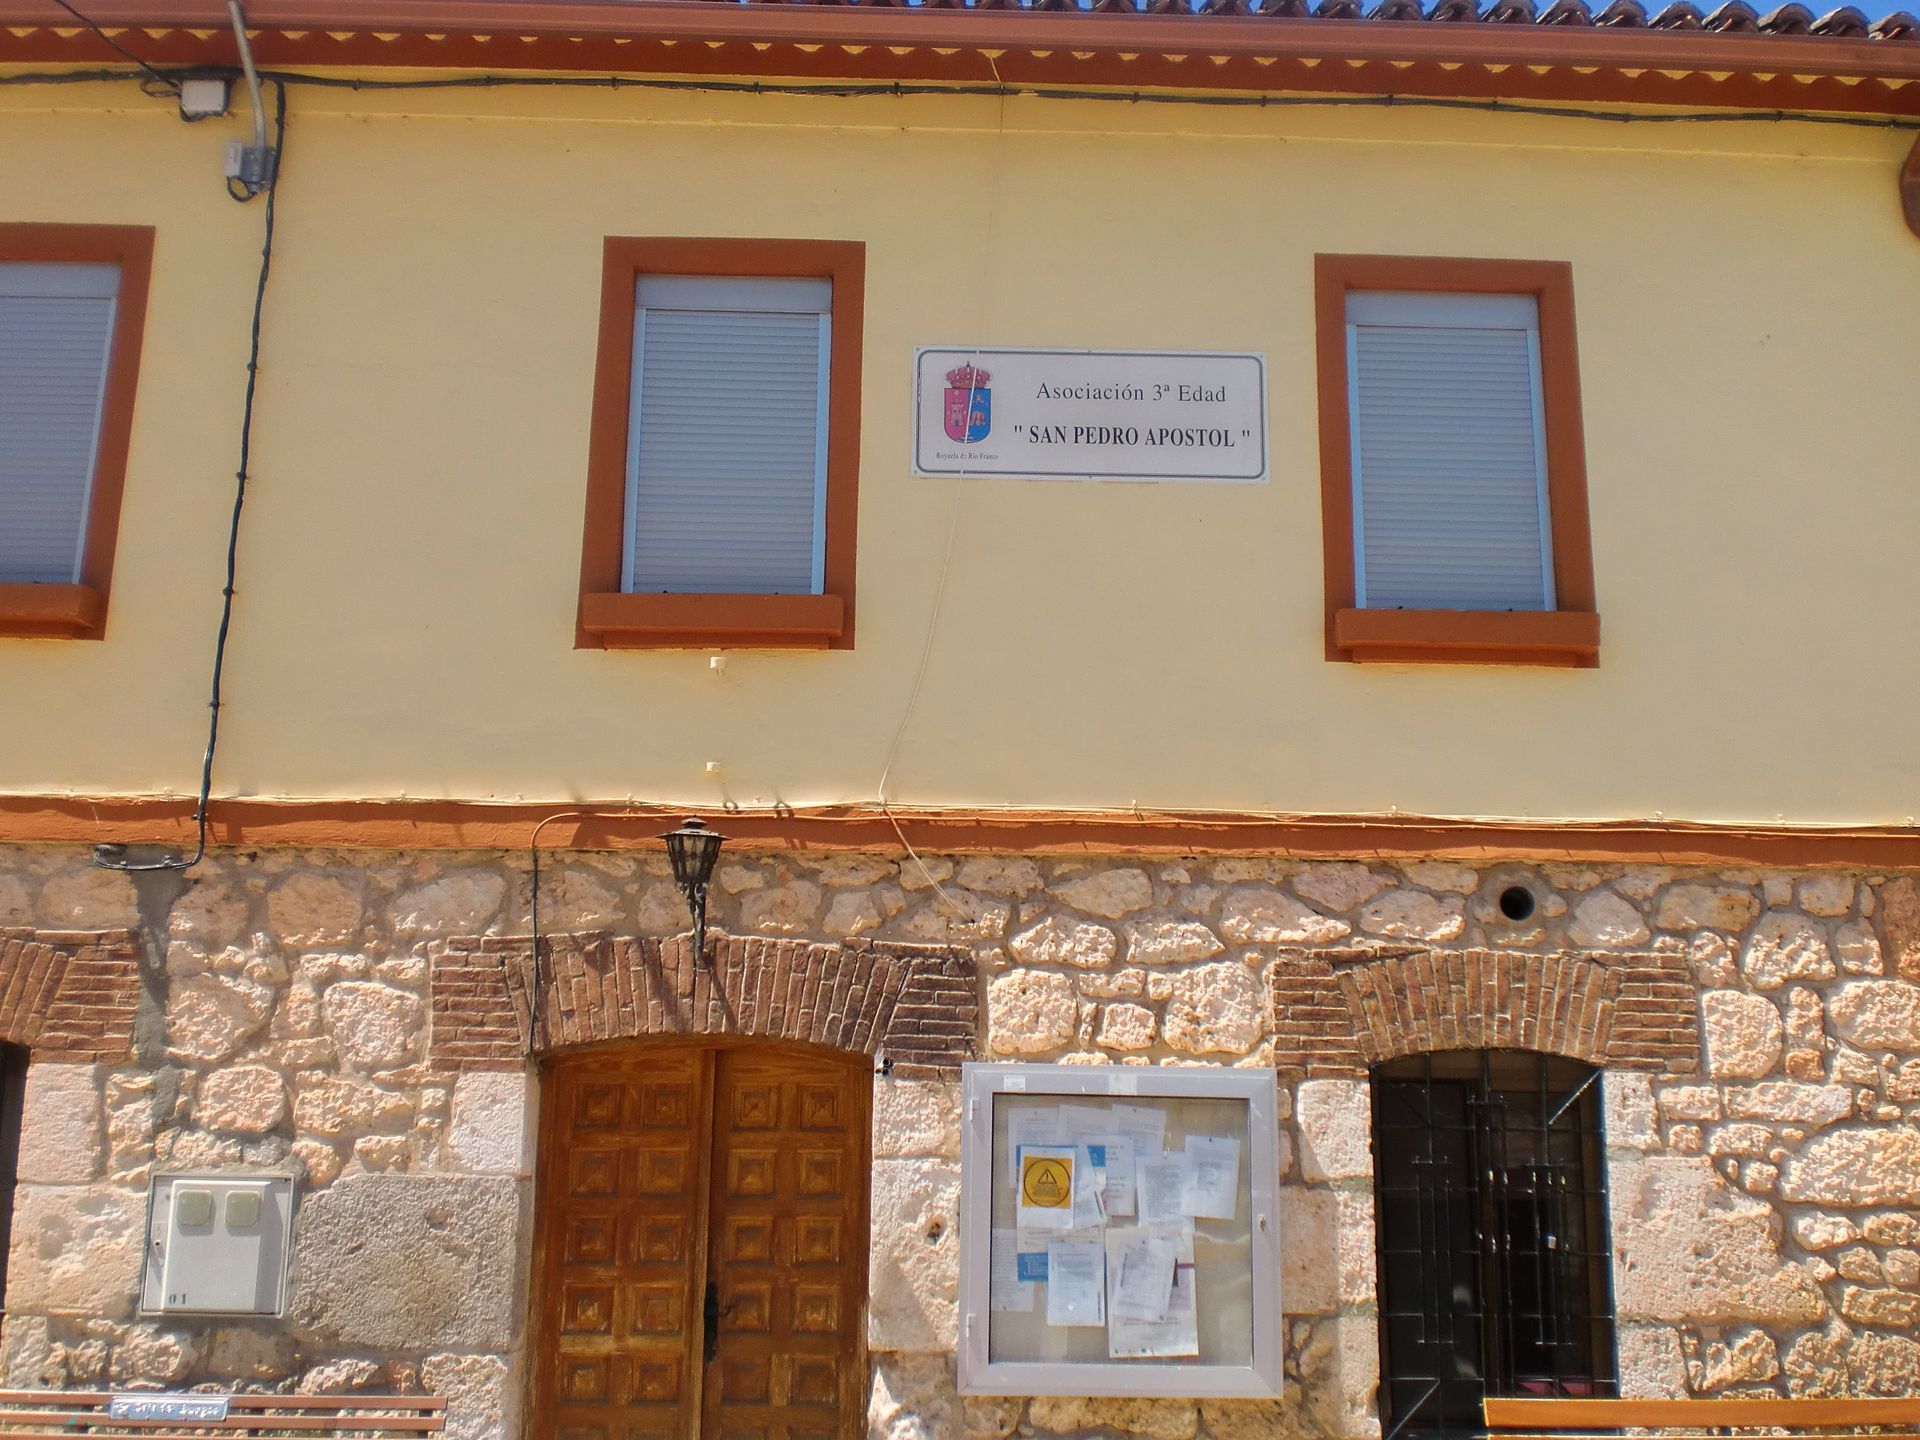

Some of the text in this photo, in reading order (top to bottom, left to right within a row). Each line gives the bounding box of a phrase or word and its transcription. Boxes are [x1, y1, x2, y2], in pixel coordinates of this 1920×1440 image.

[1036, 382, 1226, 402] Asociación 3ª Edad
[1029, 425, 1067, 444] SAN
[1073, 426, 1138, 446] PEDRO
[1145, 427, 1235, 447] APOSTOL
